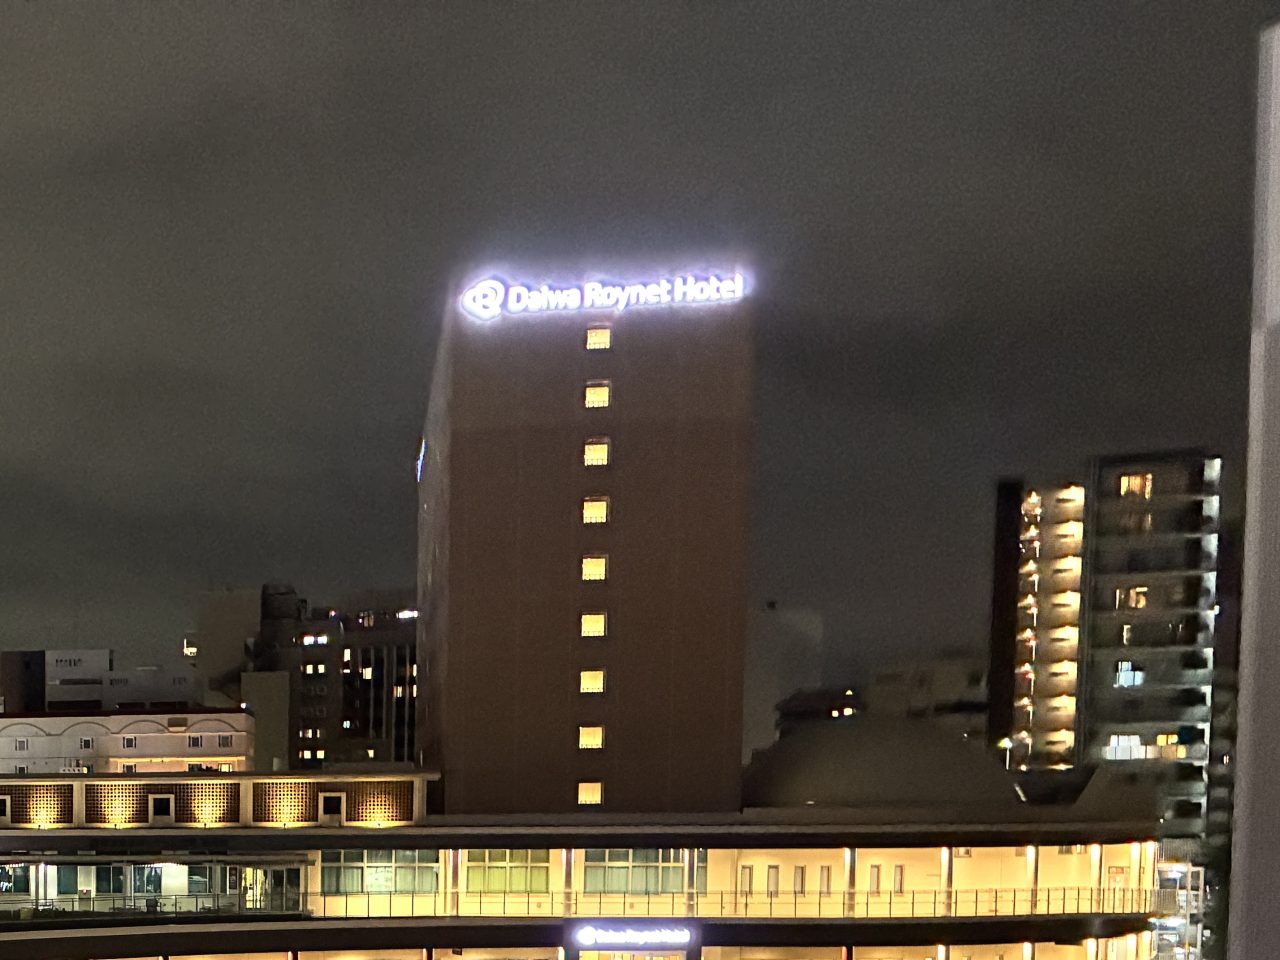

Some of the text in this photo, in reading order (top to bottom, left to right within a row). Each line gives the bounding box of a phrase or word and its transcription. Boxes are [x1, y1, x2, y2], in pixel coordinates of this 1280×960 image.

[507, 272, 744, 313] Daiwa Roynet Hotel
